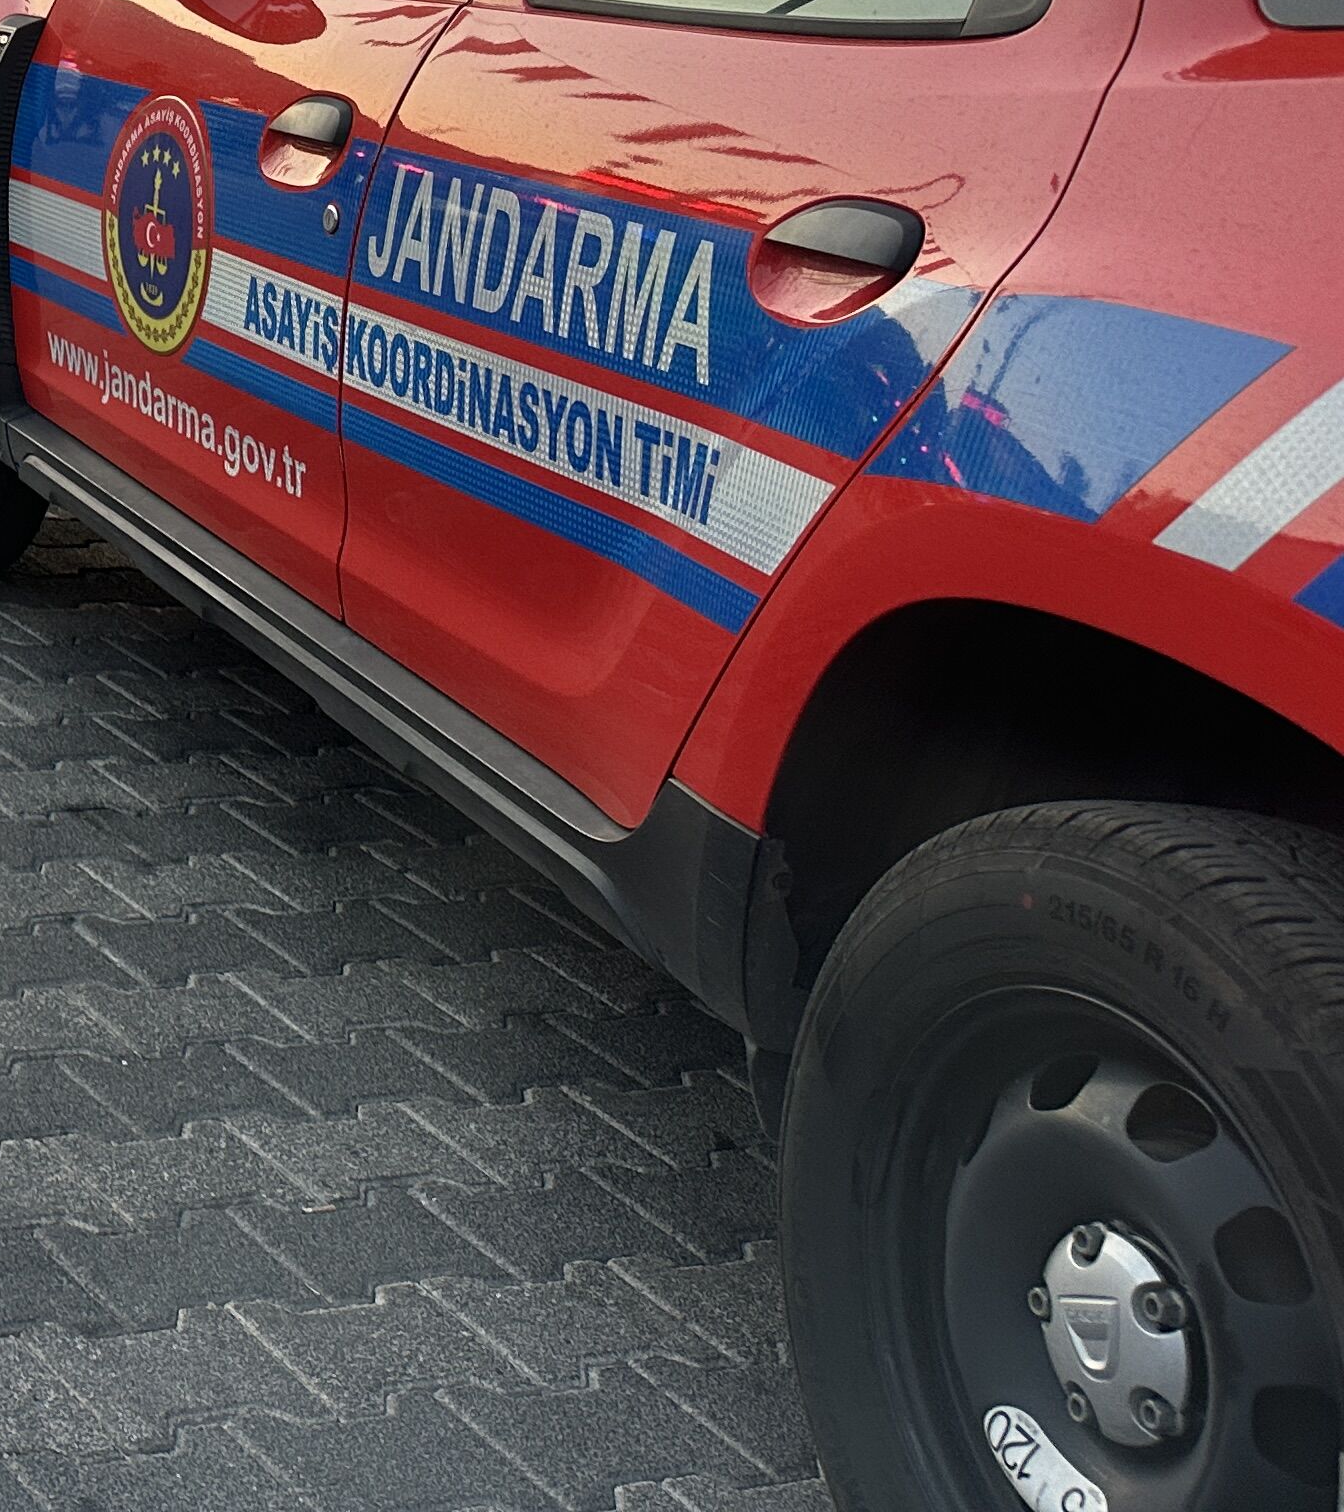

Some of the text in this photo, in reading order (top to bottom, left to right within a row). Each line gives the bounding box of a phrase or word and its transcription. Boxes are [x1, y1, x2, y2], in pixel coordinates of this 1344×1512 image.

[111, 123, 144, 205] JANDARMA
[244, 275, 340, 371] ASAYİŞ
[368, 168, 717, 386] JANDARMA
[47, 327, 308, 499] www.jandarma.gov.tr
